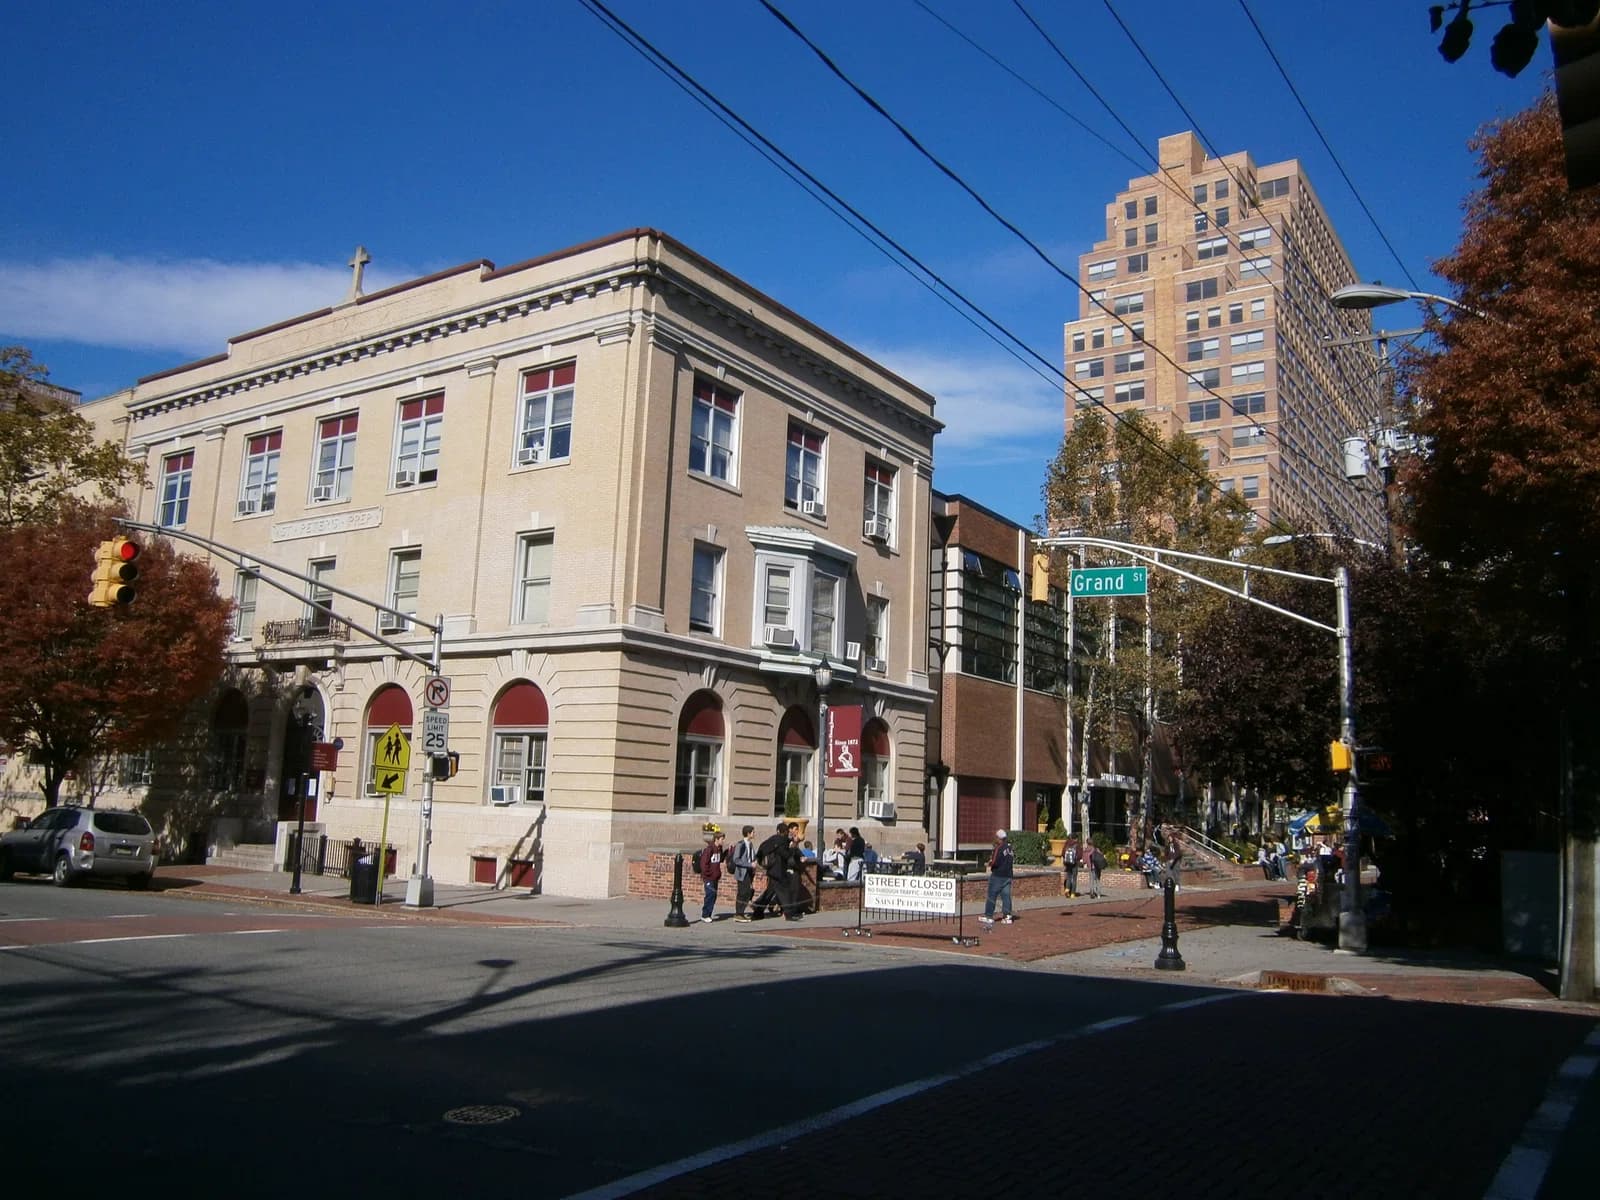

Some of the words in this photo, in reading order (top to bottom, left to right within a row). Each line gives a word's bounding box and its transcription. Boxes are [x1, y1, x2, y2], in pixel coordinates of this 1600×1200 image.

[1074, 573, 1124, 591] Grand
[1133, 572, 1143, 582] St
[426, 715, 447, 724] SPEED
[426, 732, 445, 748] 25
[867, 876, 906, 888] STREET
[910, 878, 953, 891] CLOSED
